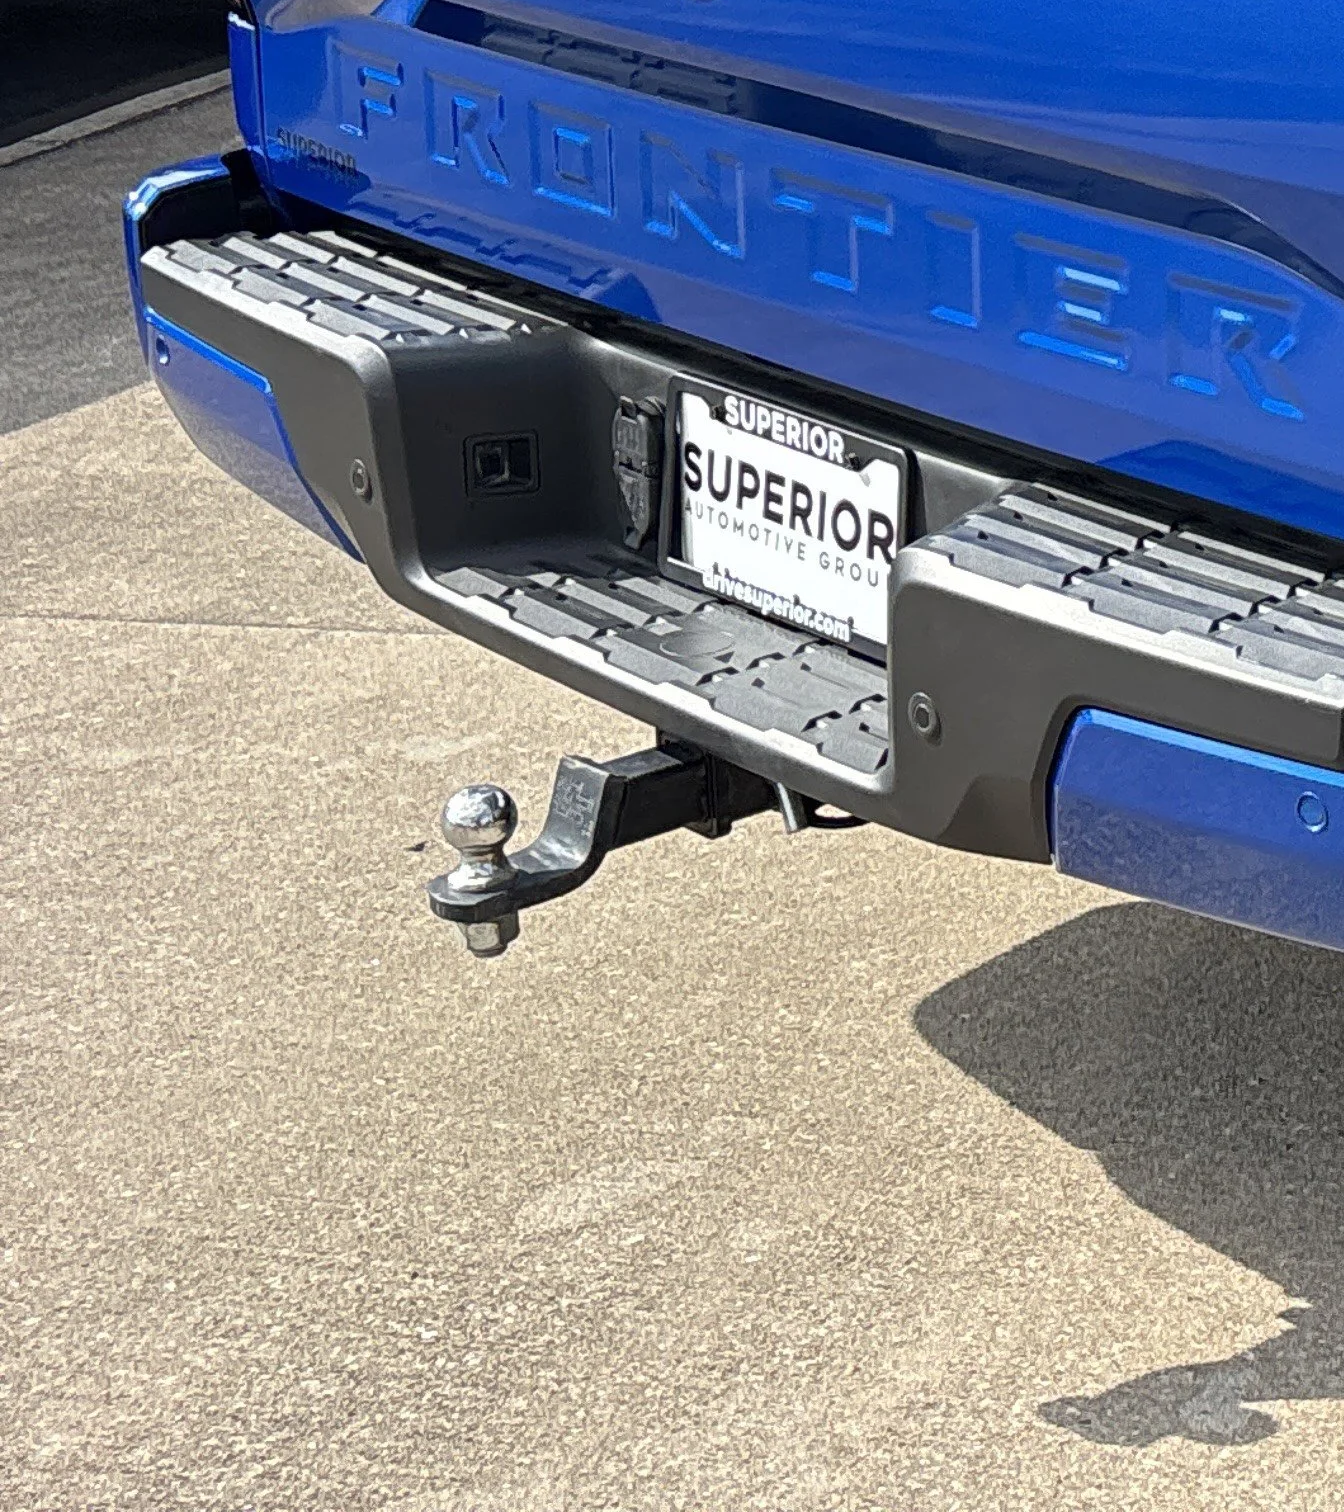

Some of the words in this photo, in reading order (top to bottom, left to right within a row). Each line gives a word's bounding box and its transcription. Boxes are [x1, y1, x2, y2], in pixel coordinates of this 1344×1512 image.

[328, 37, 1306, 422] FRONTIER
[724, 395, 845, 464] SUPERIOR
[684, 441, 896, 565] SUPERIOR
[685, 498, 807, 561] AUTOMOTIVE
[819, 551, 880, 588] GROU
[702, 561, 851, 643] drivesuperior.com
